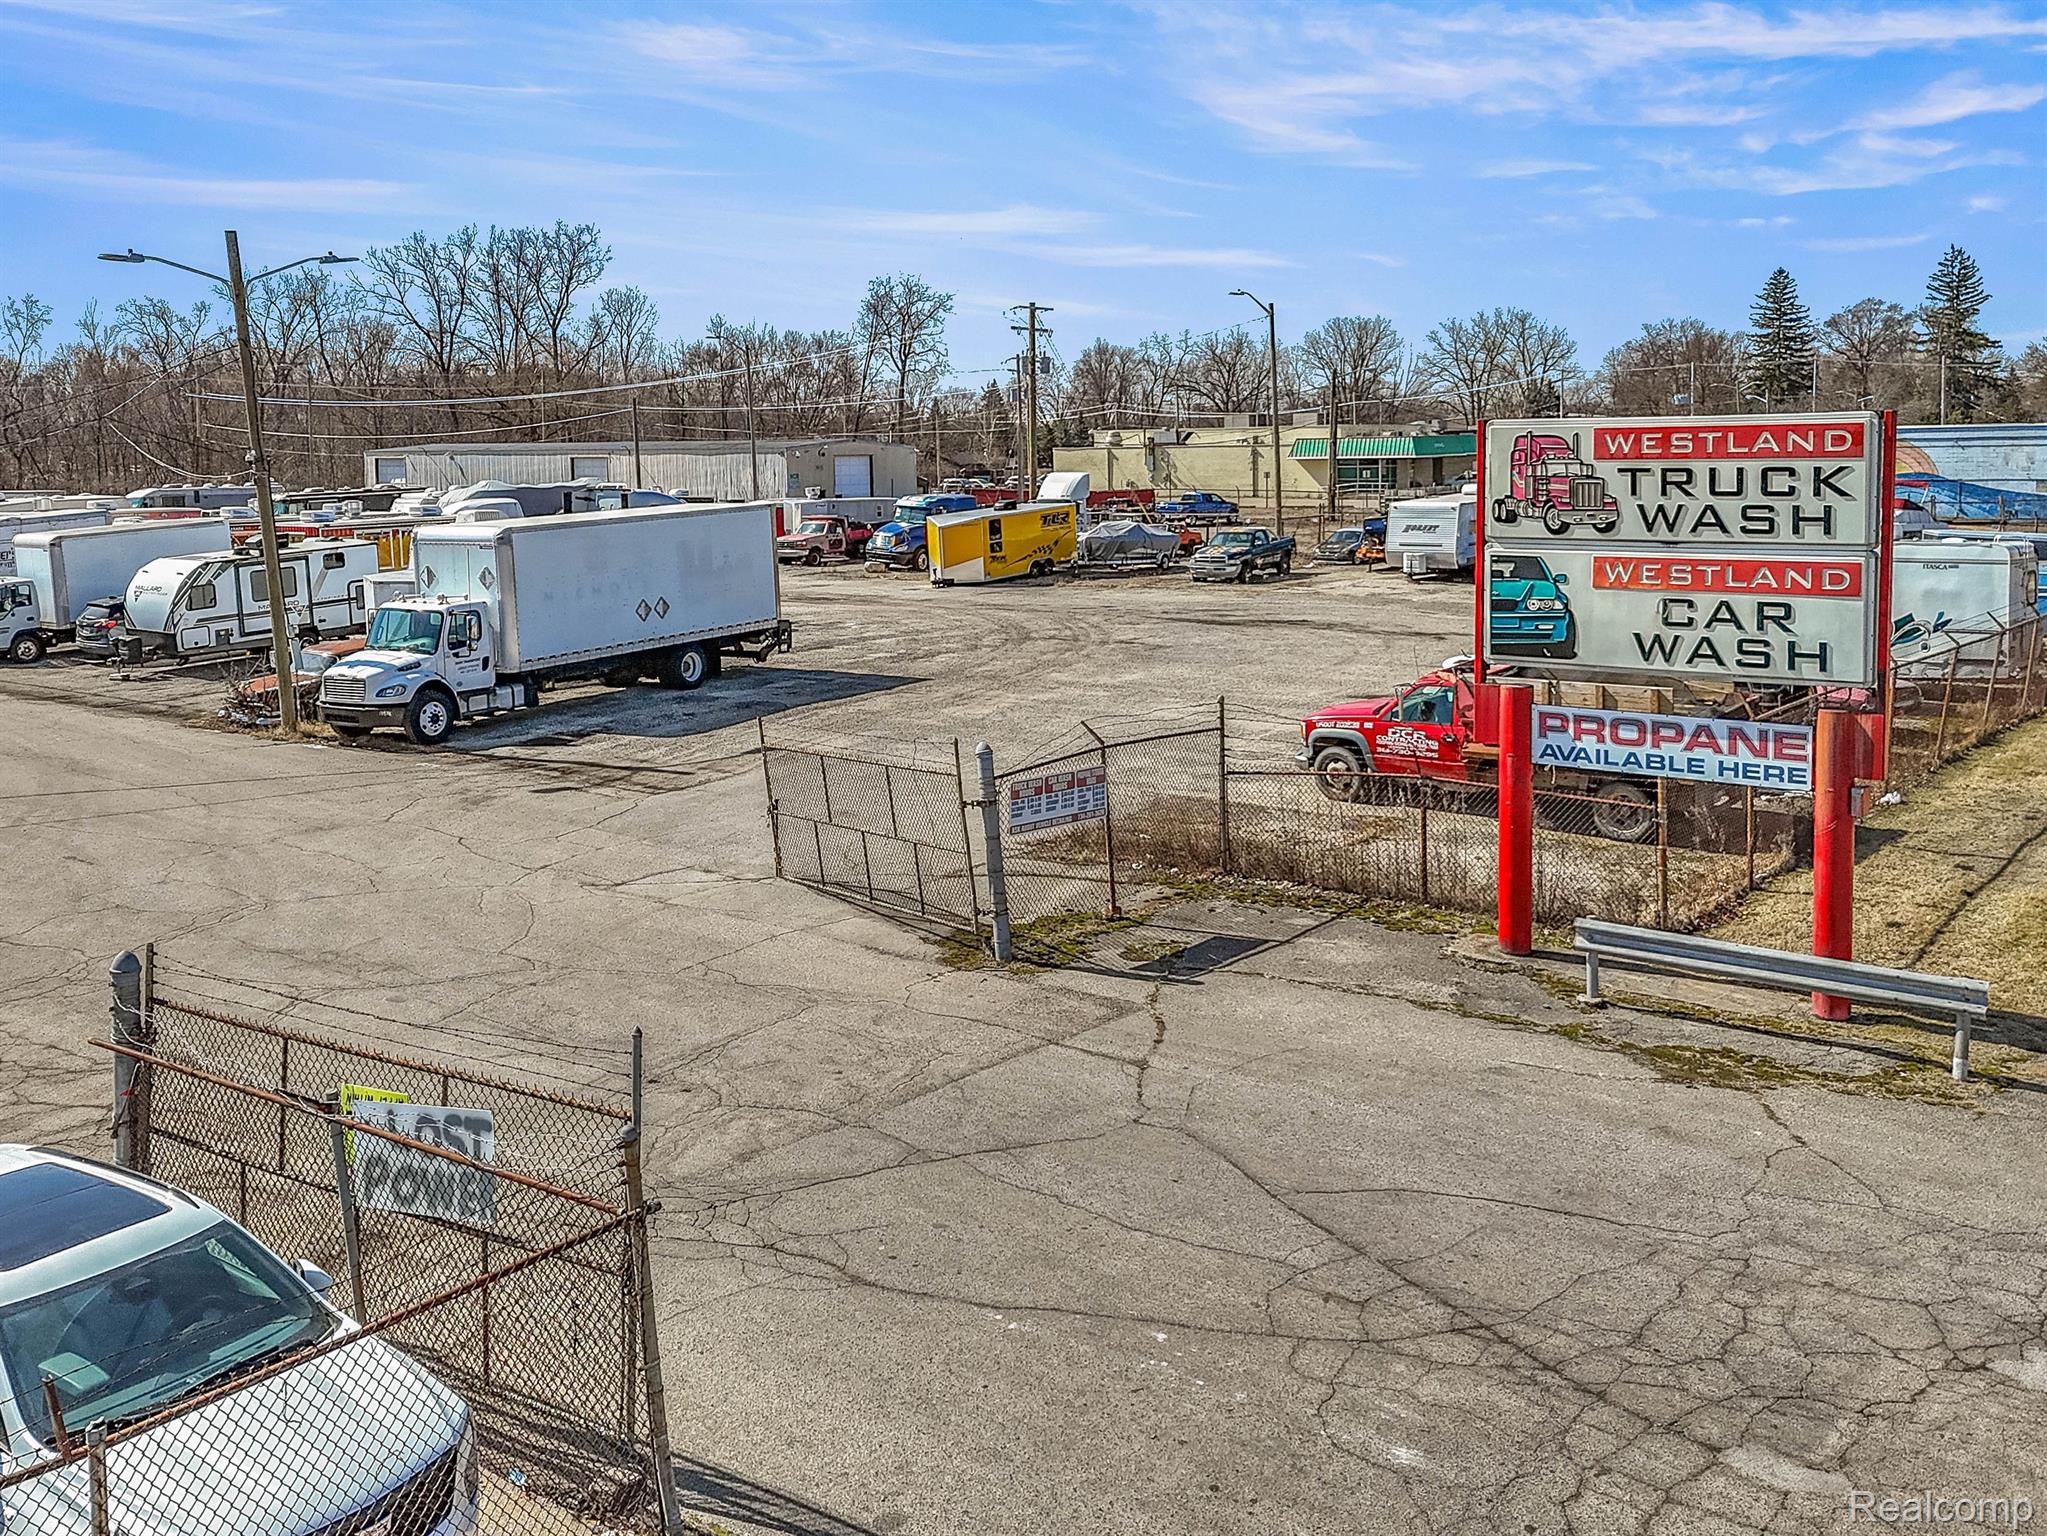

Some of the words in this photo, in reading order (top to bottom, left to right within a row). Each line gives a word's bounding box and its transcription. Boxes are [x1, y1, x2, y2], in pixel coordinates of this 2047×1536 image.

[1603, 430, 1853, 454] WESTLAND
[1617, 465, 1857, 500] TRUCK
[1636, 503, 1837, 538] WASH
[1603, 561, 1851, 590] WESTLAND
[1661, 597, 1799, 636] CAR
[1632, 632, 1831, 673] WASH
[1376, 735, 1439, 750] CONTRACTING
[1537, 711, 1810, 762] PROPANE
[1539, 743, 1705, 775] AVAILABLE
[1717, 760, 1808, 785] HERE
[387, 1109, 493, 1166] LOST
[363, 1154, 498, 1223] POWER
